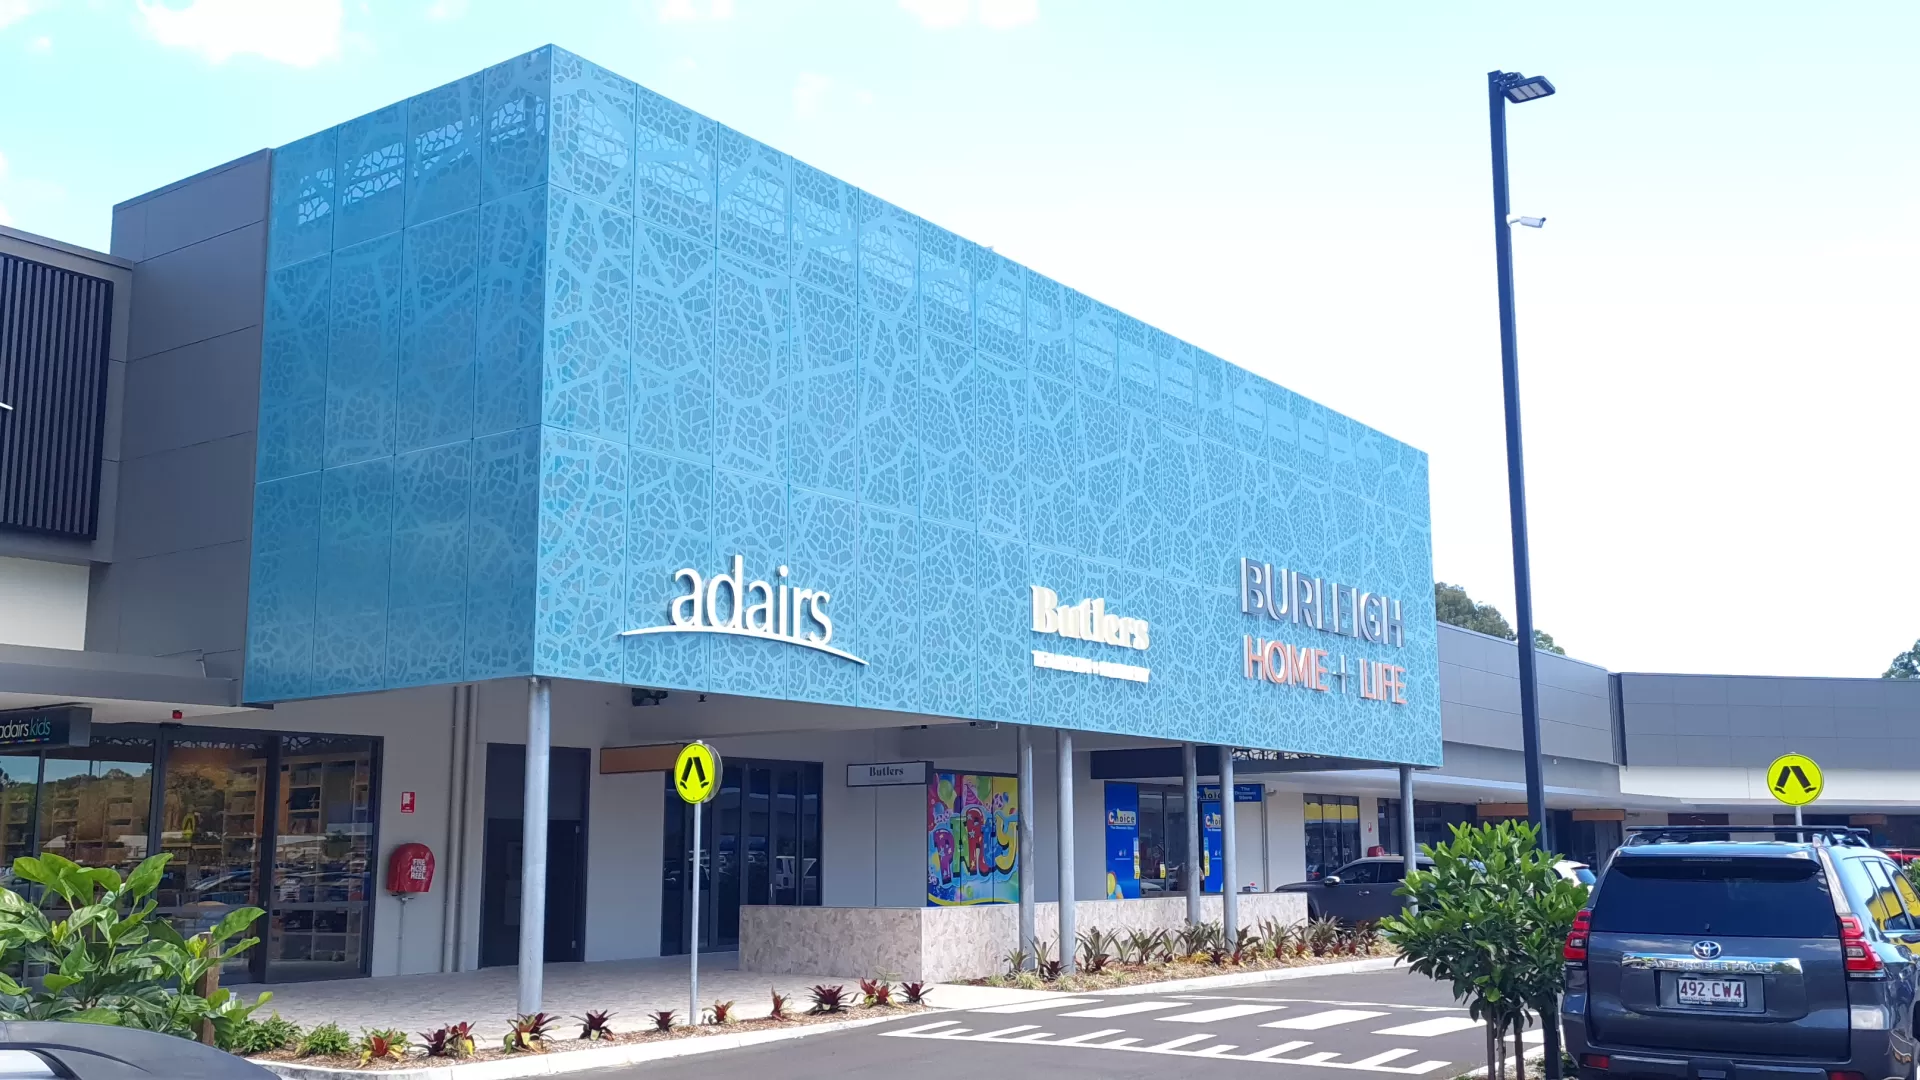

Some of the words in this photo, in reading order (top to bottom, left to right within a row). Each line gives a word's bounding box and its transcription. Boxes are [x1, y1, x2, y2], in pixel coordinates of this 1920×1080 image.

[668, 555, 833, 646] adairs
[1240, 557, 1404, 648] BURLEIGH
[1030, 585, 1149, 650] Butlers
[1243, 634, 1329, 692] HOME
[1359, 658, 1407, 705] LIFE
[30, 716, 51, 735] kids
[869, 766, 904, 777] Butlers
[410, 865, 427, 873] HOSE
[413, 858, 426, 866] FIRE
[410, 872, 426, 880] REEL
[1731, 962, 1773, 973] PRADO
